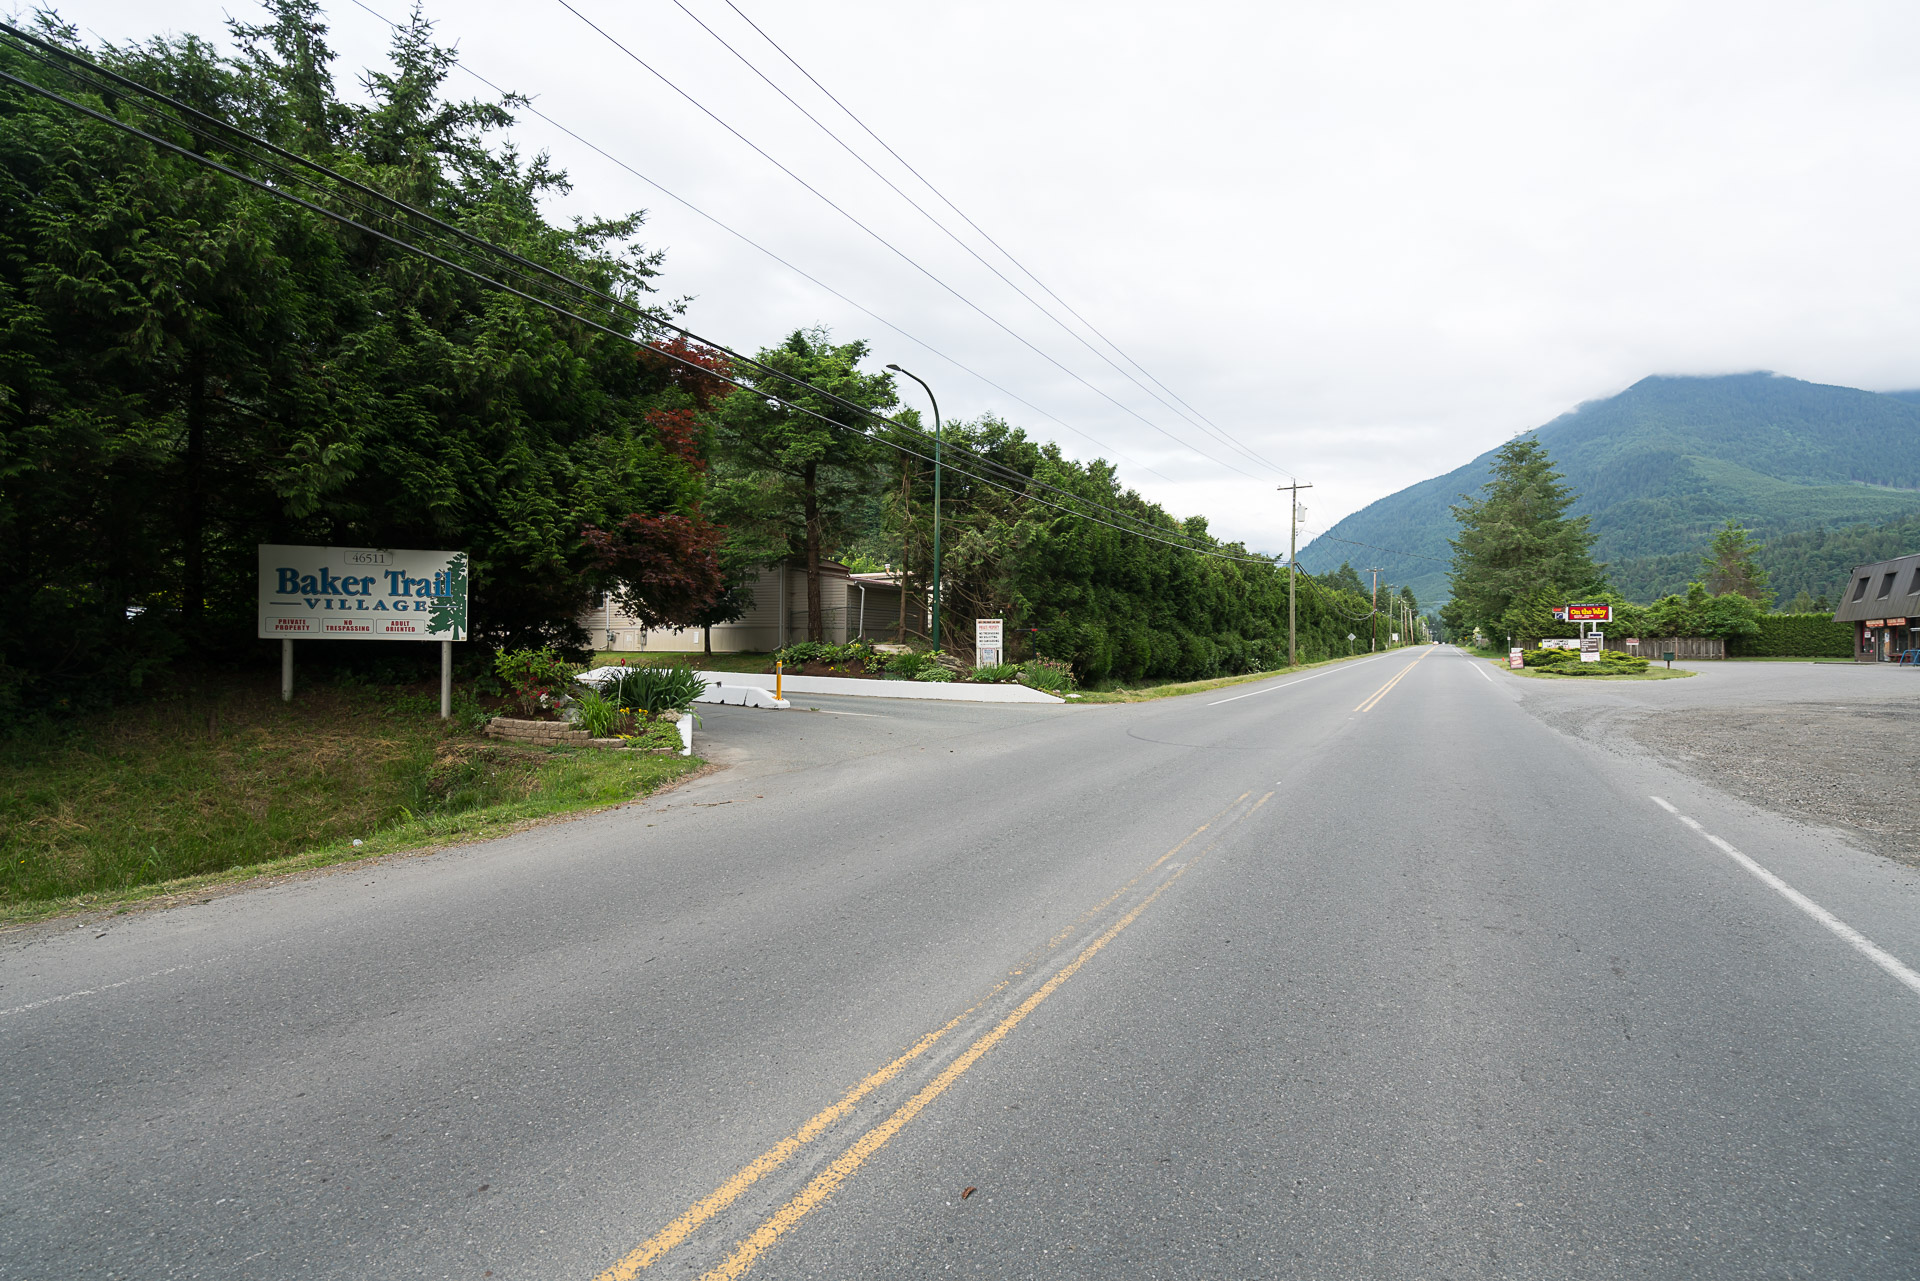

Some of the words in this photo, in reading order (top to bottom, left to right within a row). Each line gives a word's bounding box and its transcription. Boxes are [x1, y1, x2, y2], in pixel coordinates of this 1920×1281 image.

[352, 553, 385, 564] 46511
[275, 566, 376, 597] Baker
[384, 568, 454, 598] Trail
[303, 598, 428, 612] VILLAGE
[1581, 607, 1592, 615] the
[1592, 607, 1607, 618] Way
